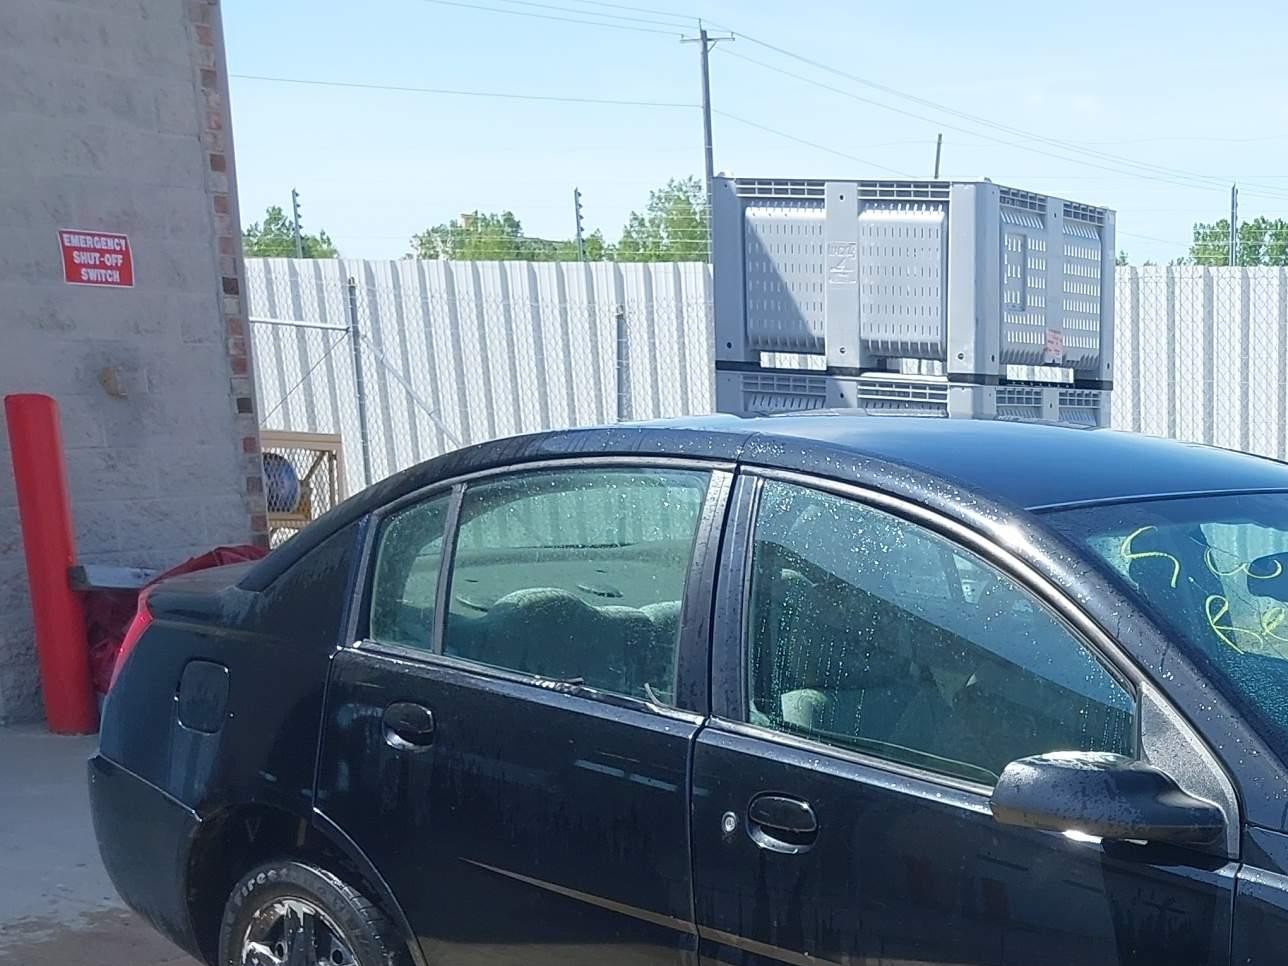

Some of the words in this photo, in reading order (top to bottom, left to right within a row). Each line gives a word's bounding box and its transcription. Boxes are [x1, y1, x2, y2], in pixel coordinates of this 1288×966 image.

[62, 234, 126, 251] EMERGENCY
[73, 251, 123, 266] SHUT-OFF
[81, 268, 120, 283] SWITCH
